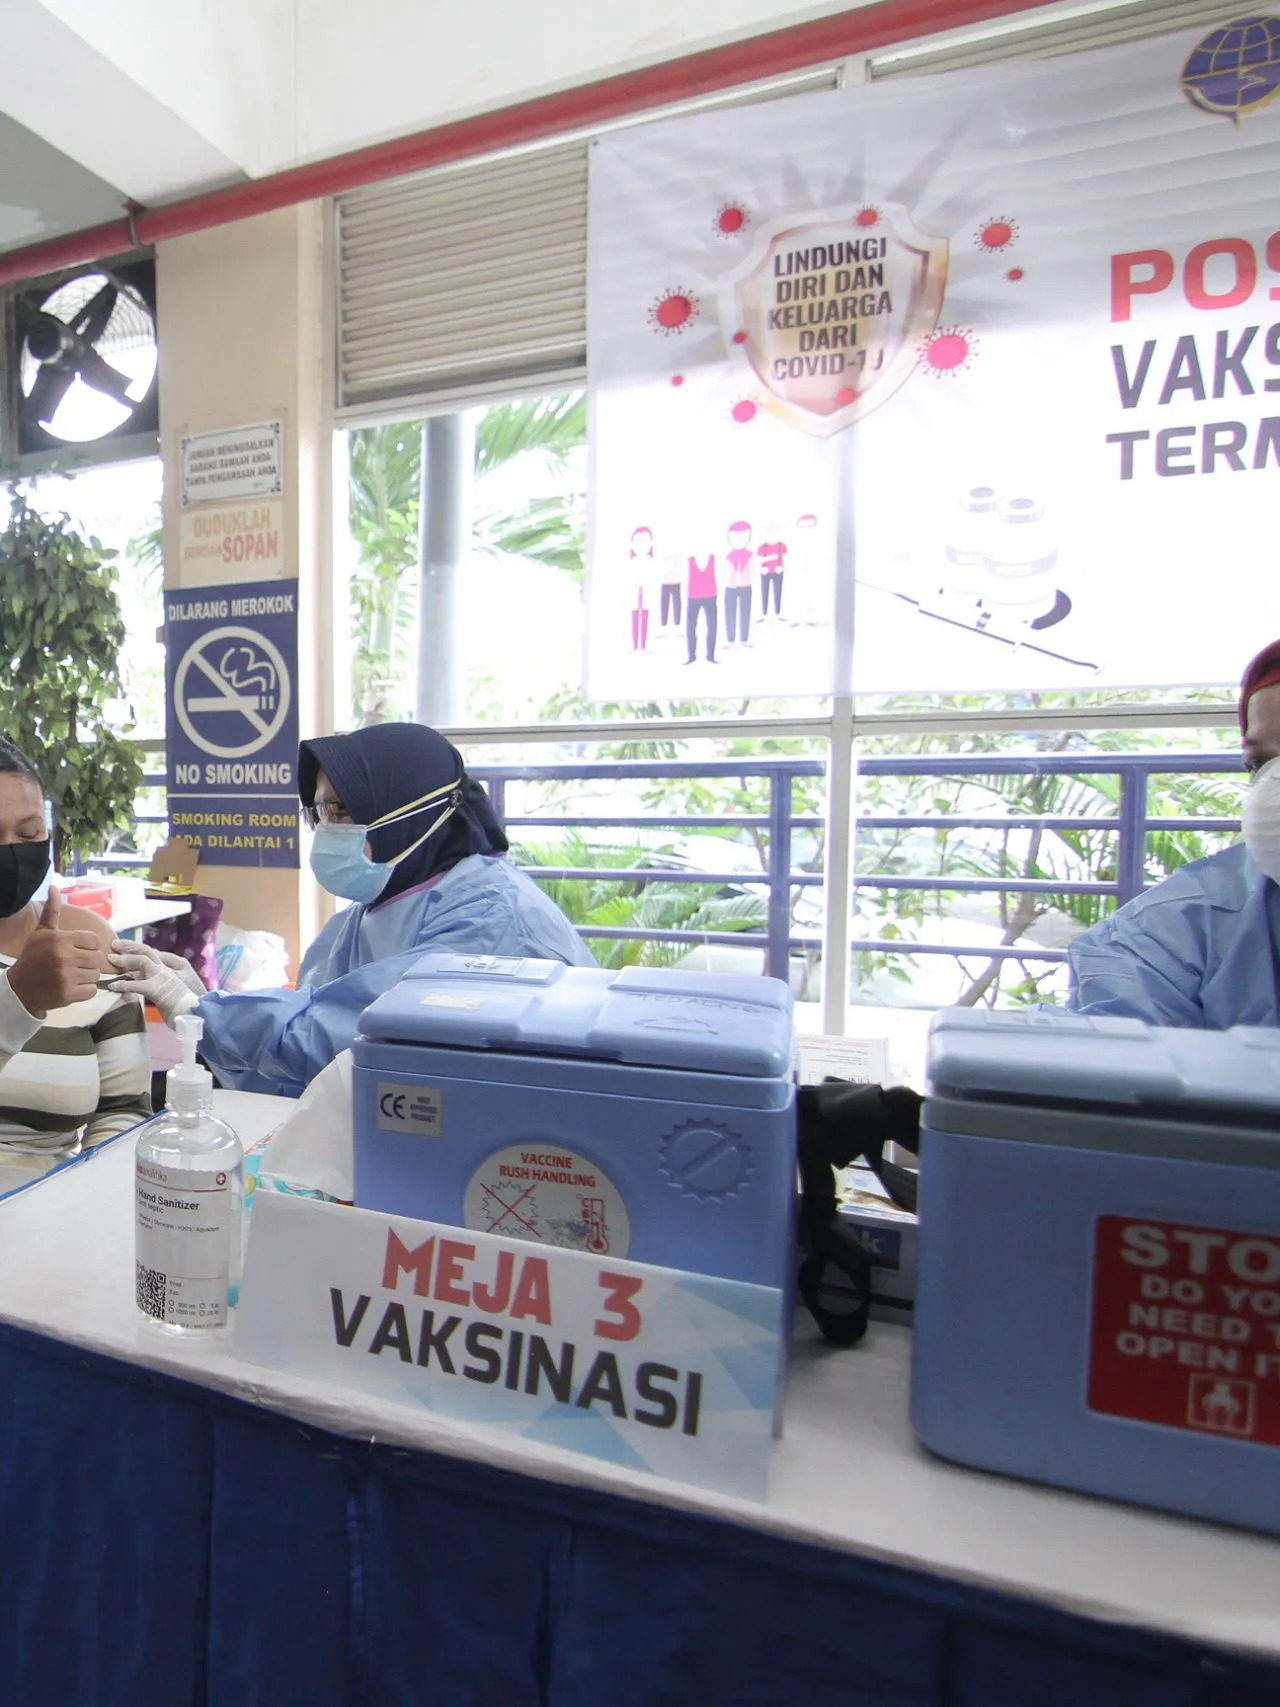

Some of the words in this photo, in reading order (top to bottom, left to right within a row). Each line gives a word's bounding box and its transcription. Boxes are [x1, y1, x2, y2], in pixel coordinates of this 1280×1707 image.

[774, 237, 887, 277] LINDUNGI
[776, 274, 826, 303] DIRI
[835, 263, 883, 293] DAN
[1111, 230, 1280, 323] POS
[769, 291, 893, 330] KELUARGA
[799, 324, 857, 352] DARI
[194, 506, 270, 538] DUDUKLAH
[222, 531, 278, 563] SOPAN
[169, 600, 228, 621] DILARANG
[231, 595, 294, 617] MEROKOK
[176, 764, 200, 785] NO
[205, 763, 292, 785] SMOKING
[172, 813, 243, 826] SMOKING
[249, 814, 296, 827] ROOM
[208, 835, 281, 849] DILANTAI
[286, 837, 294, 849] 1
[499, 1165, 529, 1180] RUSH
[532, 1169, 596, 1188] HANDLING
[521, 1152, 573, 1169] VACCINE
[139, 1188, 156, 1203] Hand
[158, 1195, 200, 1211] Sanitizer
[381, 1226, 552, 1326] MEJA
[594, 1270, 644, 1342] 3
[1141, 1274, 1204, 1303] DO
[1129, 1302, 1251, 1342] NEED
[330, 1287, 703, 1437] VAKSINASI
[1116, 1331, 1238, 1372] OPEN
